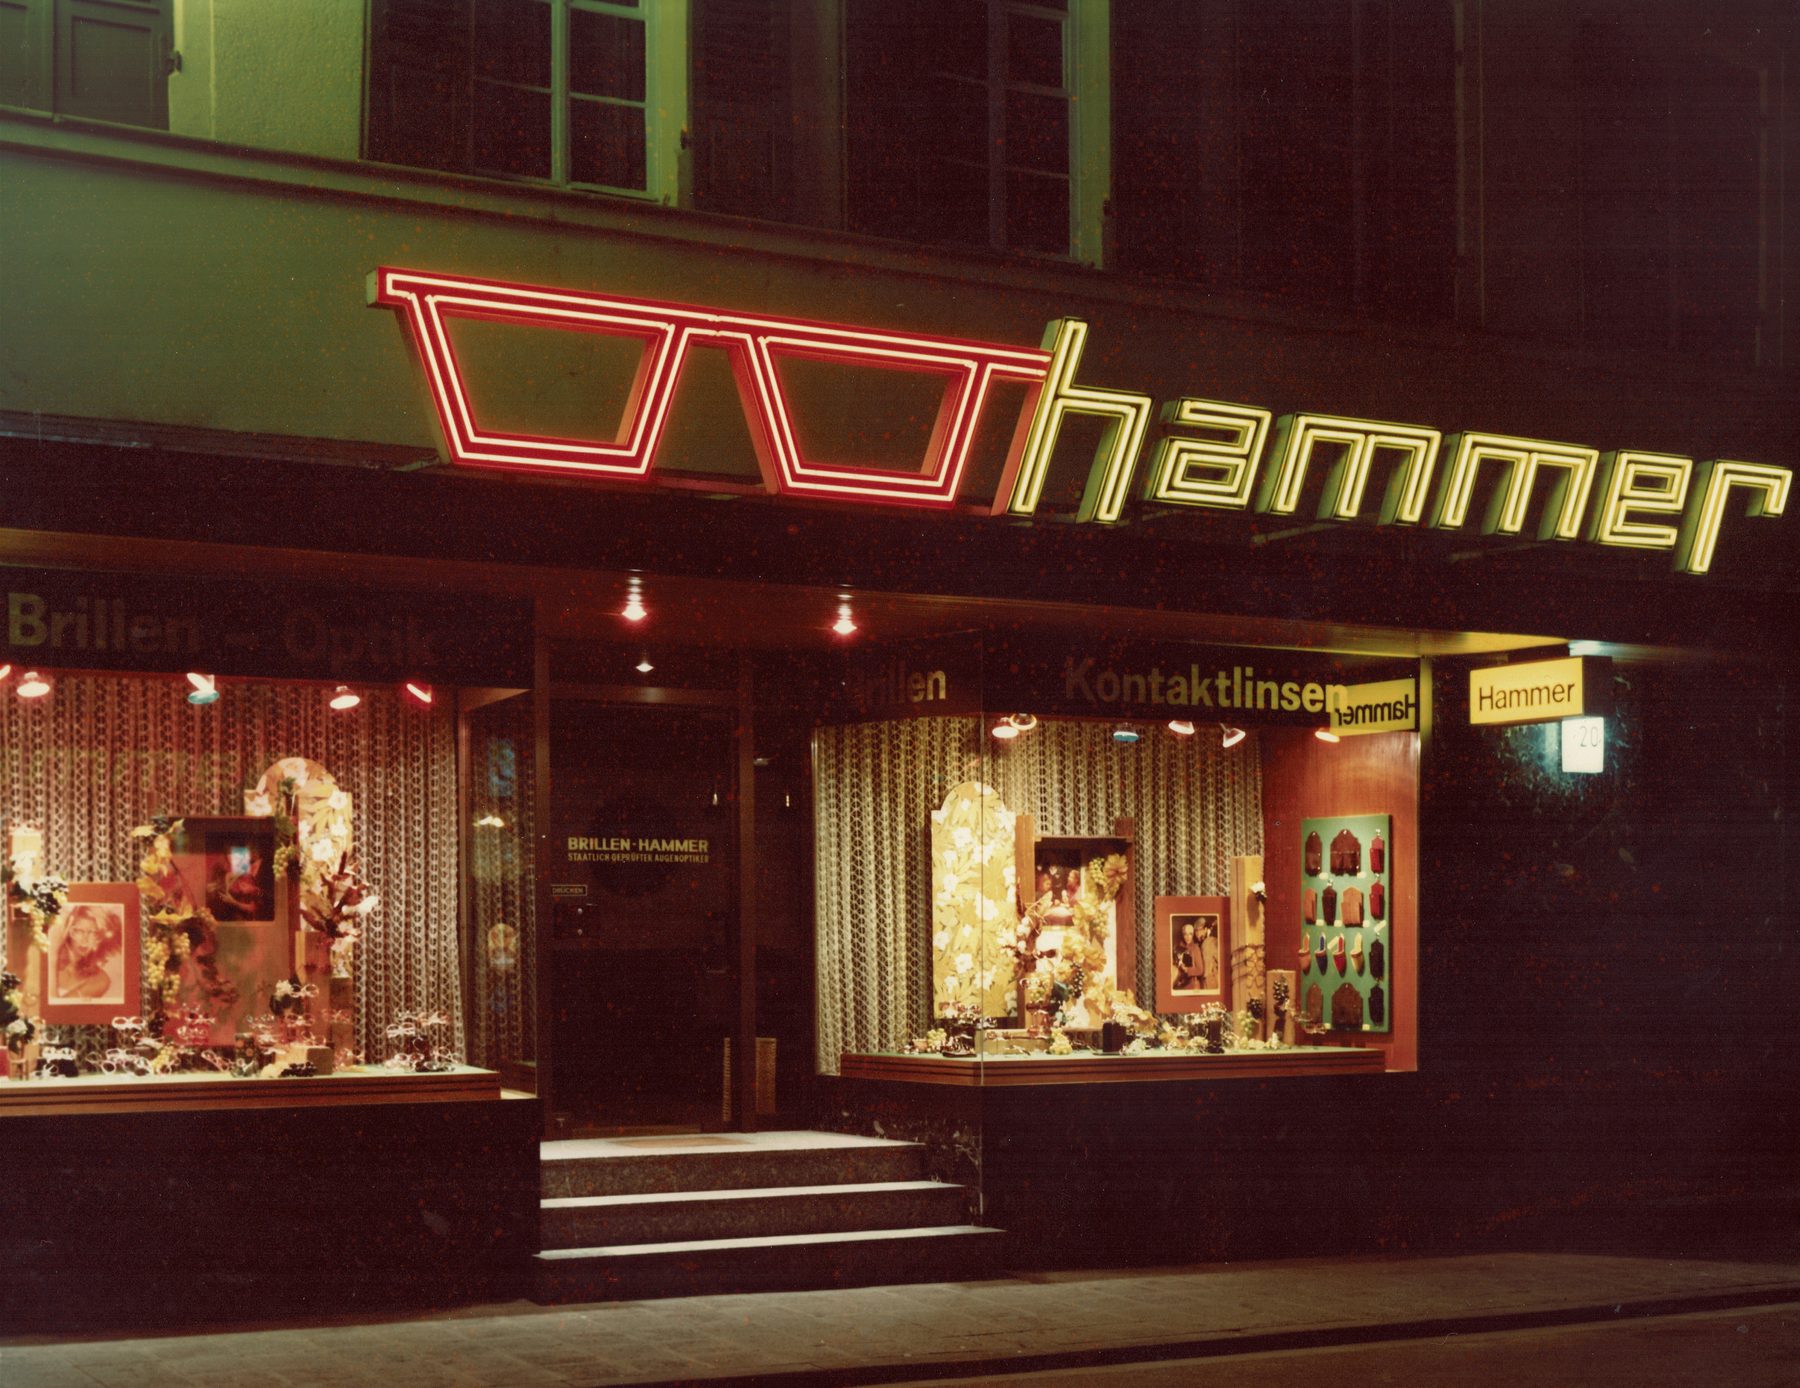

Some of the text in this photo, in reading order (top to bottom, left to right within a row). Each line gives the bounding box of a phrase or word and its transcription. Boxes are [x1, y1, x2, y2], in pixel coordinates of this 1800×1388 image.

[1006, 316, 1794, 575] hammer
[8, 592, 198, 654] Brillen
[1064, 656, 1348, 713] Kontaktlinsen
[1479, 684, 1575, 711] Hammer
[1579, 725, 1598, 747] 20
[568, 853, 609, 862] STAATLICH
[654, 854, 709, 864] AUGENOPTIKER
